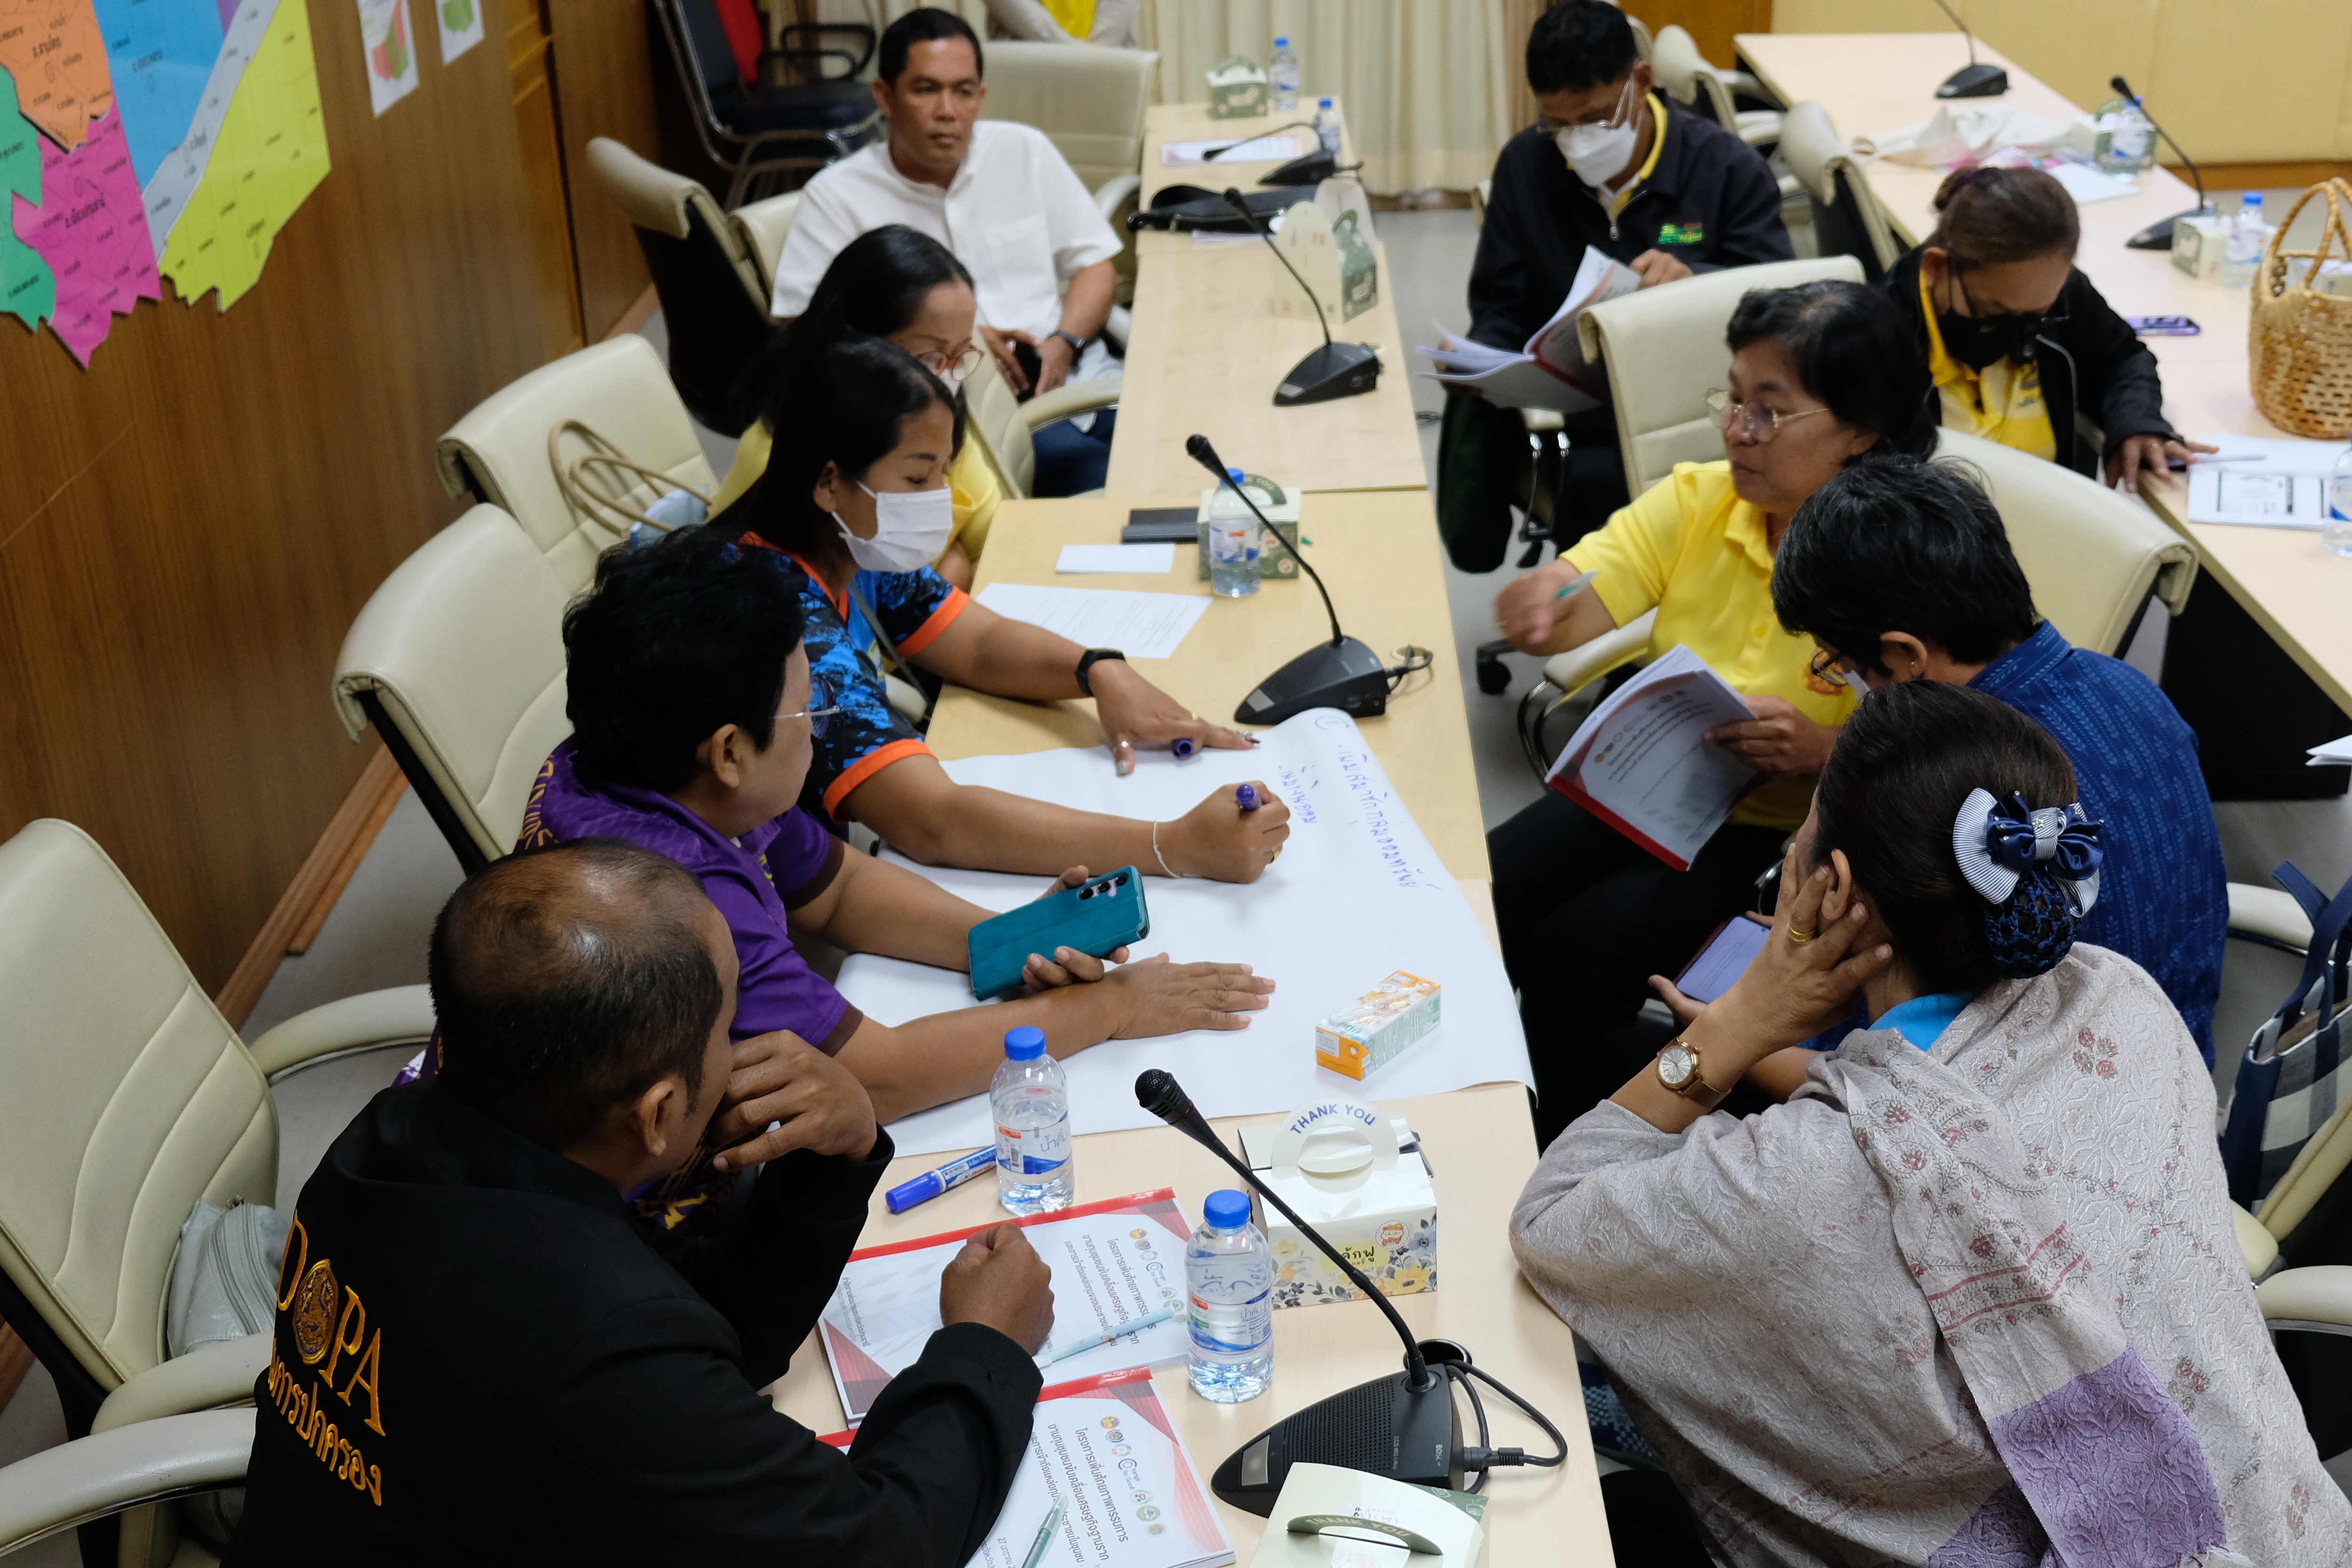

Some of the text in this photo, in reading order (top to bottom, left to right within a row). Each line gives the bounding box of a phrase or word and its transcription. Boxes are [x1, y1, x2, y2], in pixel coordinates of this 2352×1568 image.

[1290, 1103, 1376, 1135] THANK YOU
[1049, 1423, 1109, 1561] งานทุนชุมชนขับเคลื่อนเศรษฐกิจฐานราก
[1075, 1427, 1129, 1543] โครงการเพิ่มศักยภาพกรรมการ
[1305, 1517, 1411, 1537] THANK YOU
